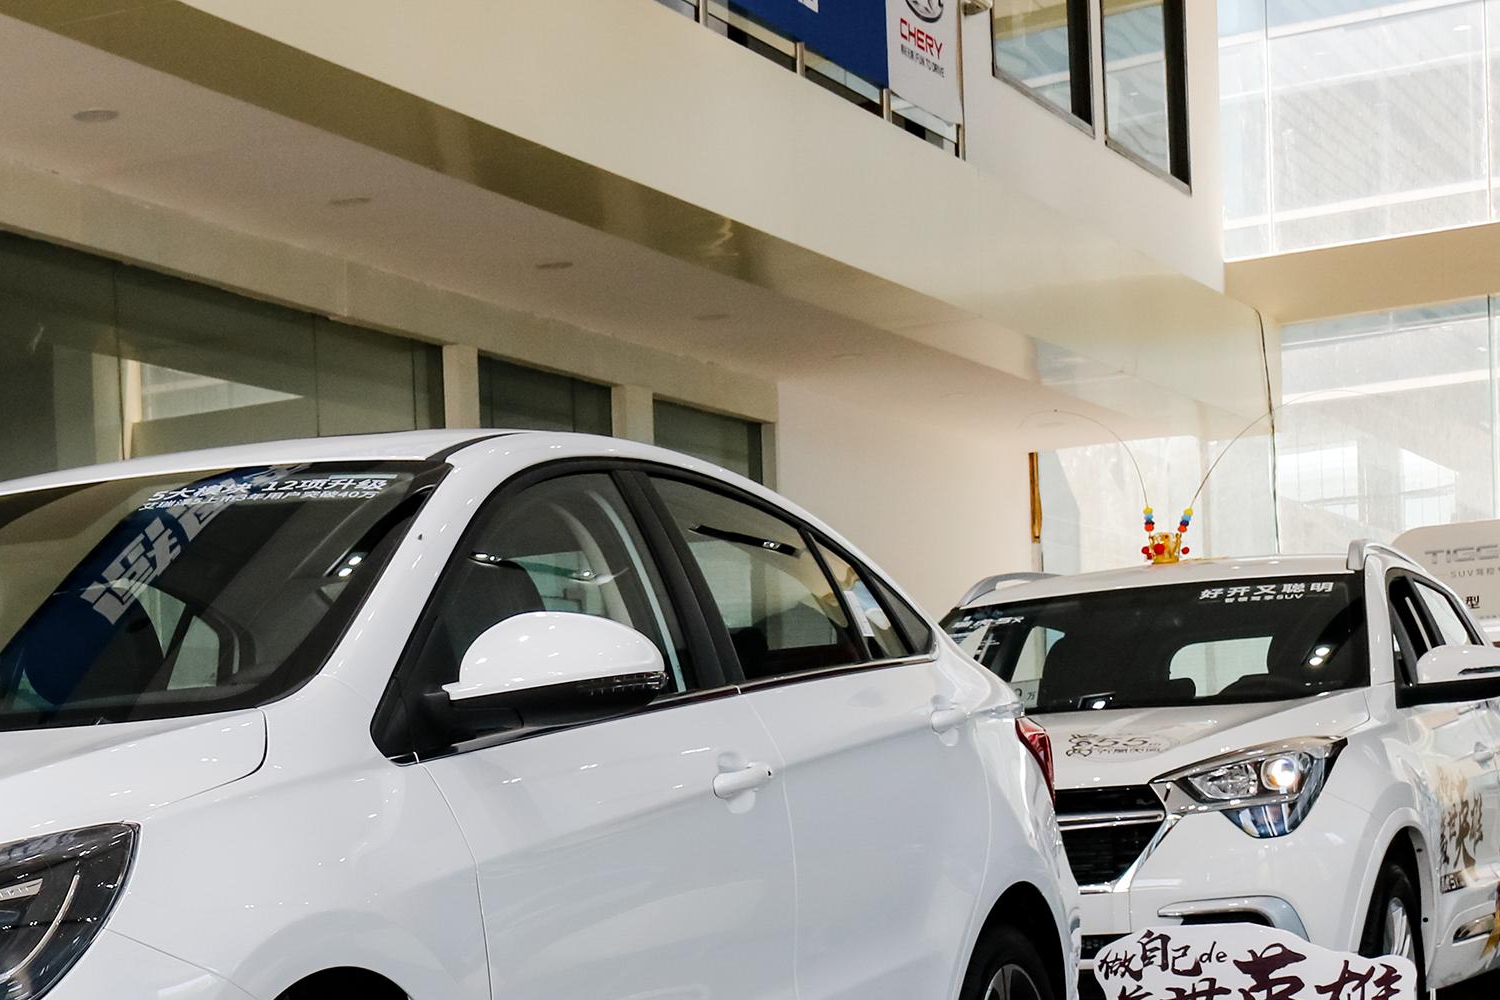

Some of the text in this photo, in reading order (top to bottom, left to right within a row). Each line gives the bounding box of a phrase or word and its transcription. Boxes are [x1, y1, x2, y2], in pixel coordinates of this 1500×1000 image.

[900, 17, 943, 60] CHERY
[261, 478, 388, 492] 12项升级
[1424, 544, 1499, 565] TIGG
[1199, 582, 1334, 600] 好开又聪明
